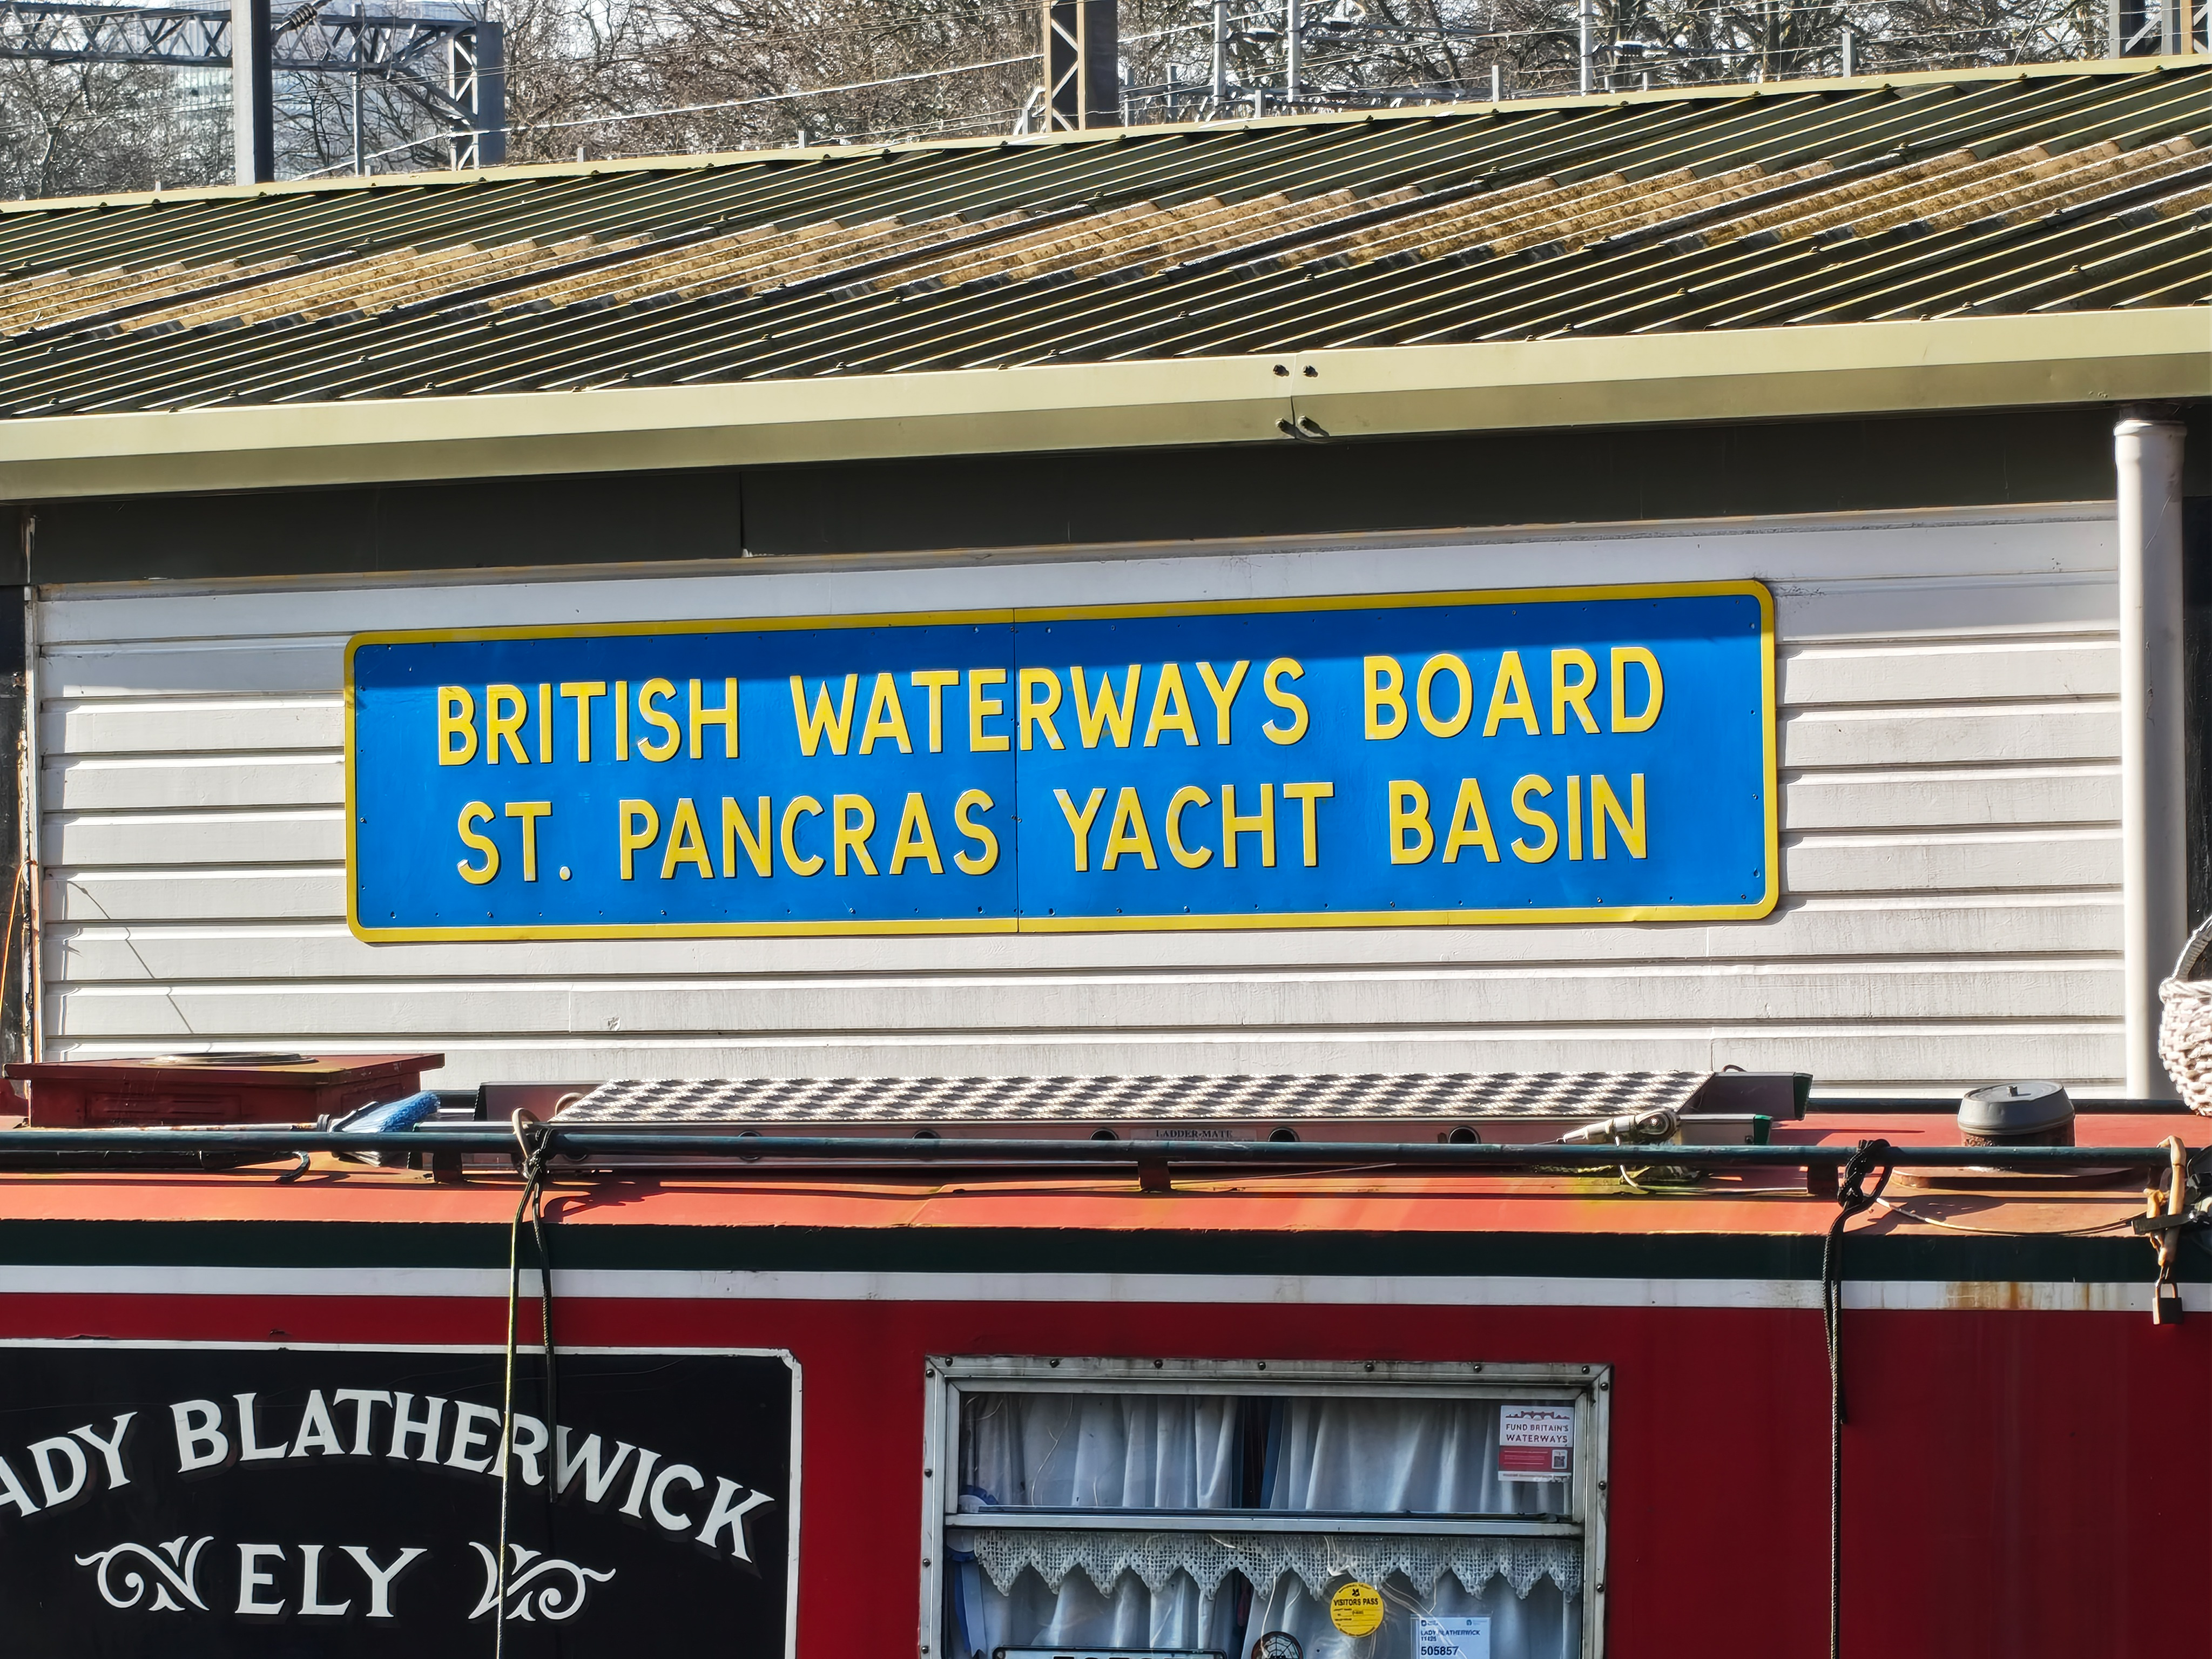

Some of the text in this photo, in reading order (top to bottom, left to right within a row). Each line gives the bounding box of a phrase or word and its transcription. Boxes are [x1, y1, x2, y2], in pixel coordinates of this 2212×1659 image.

[436, 647, 1664, 765] BRITISH WATERWAYS BOARD
[457, 774, 1647, 885] ST. PANCRAS YACHT BASIN
[1156, 1129, 1233, 1138] LADDER-MATE
[1506, 1434, 1568, 1443] WATERWAYS
[1530, 1424, 1569, 1432] BRITAIN'S
[169, 1388, 775, 1563] BLATHERWICK
[234, 1543, 428, 1618] ELY
[1421, 1645, 1459, 1656] 505857
